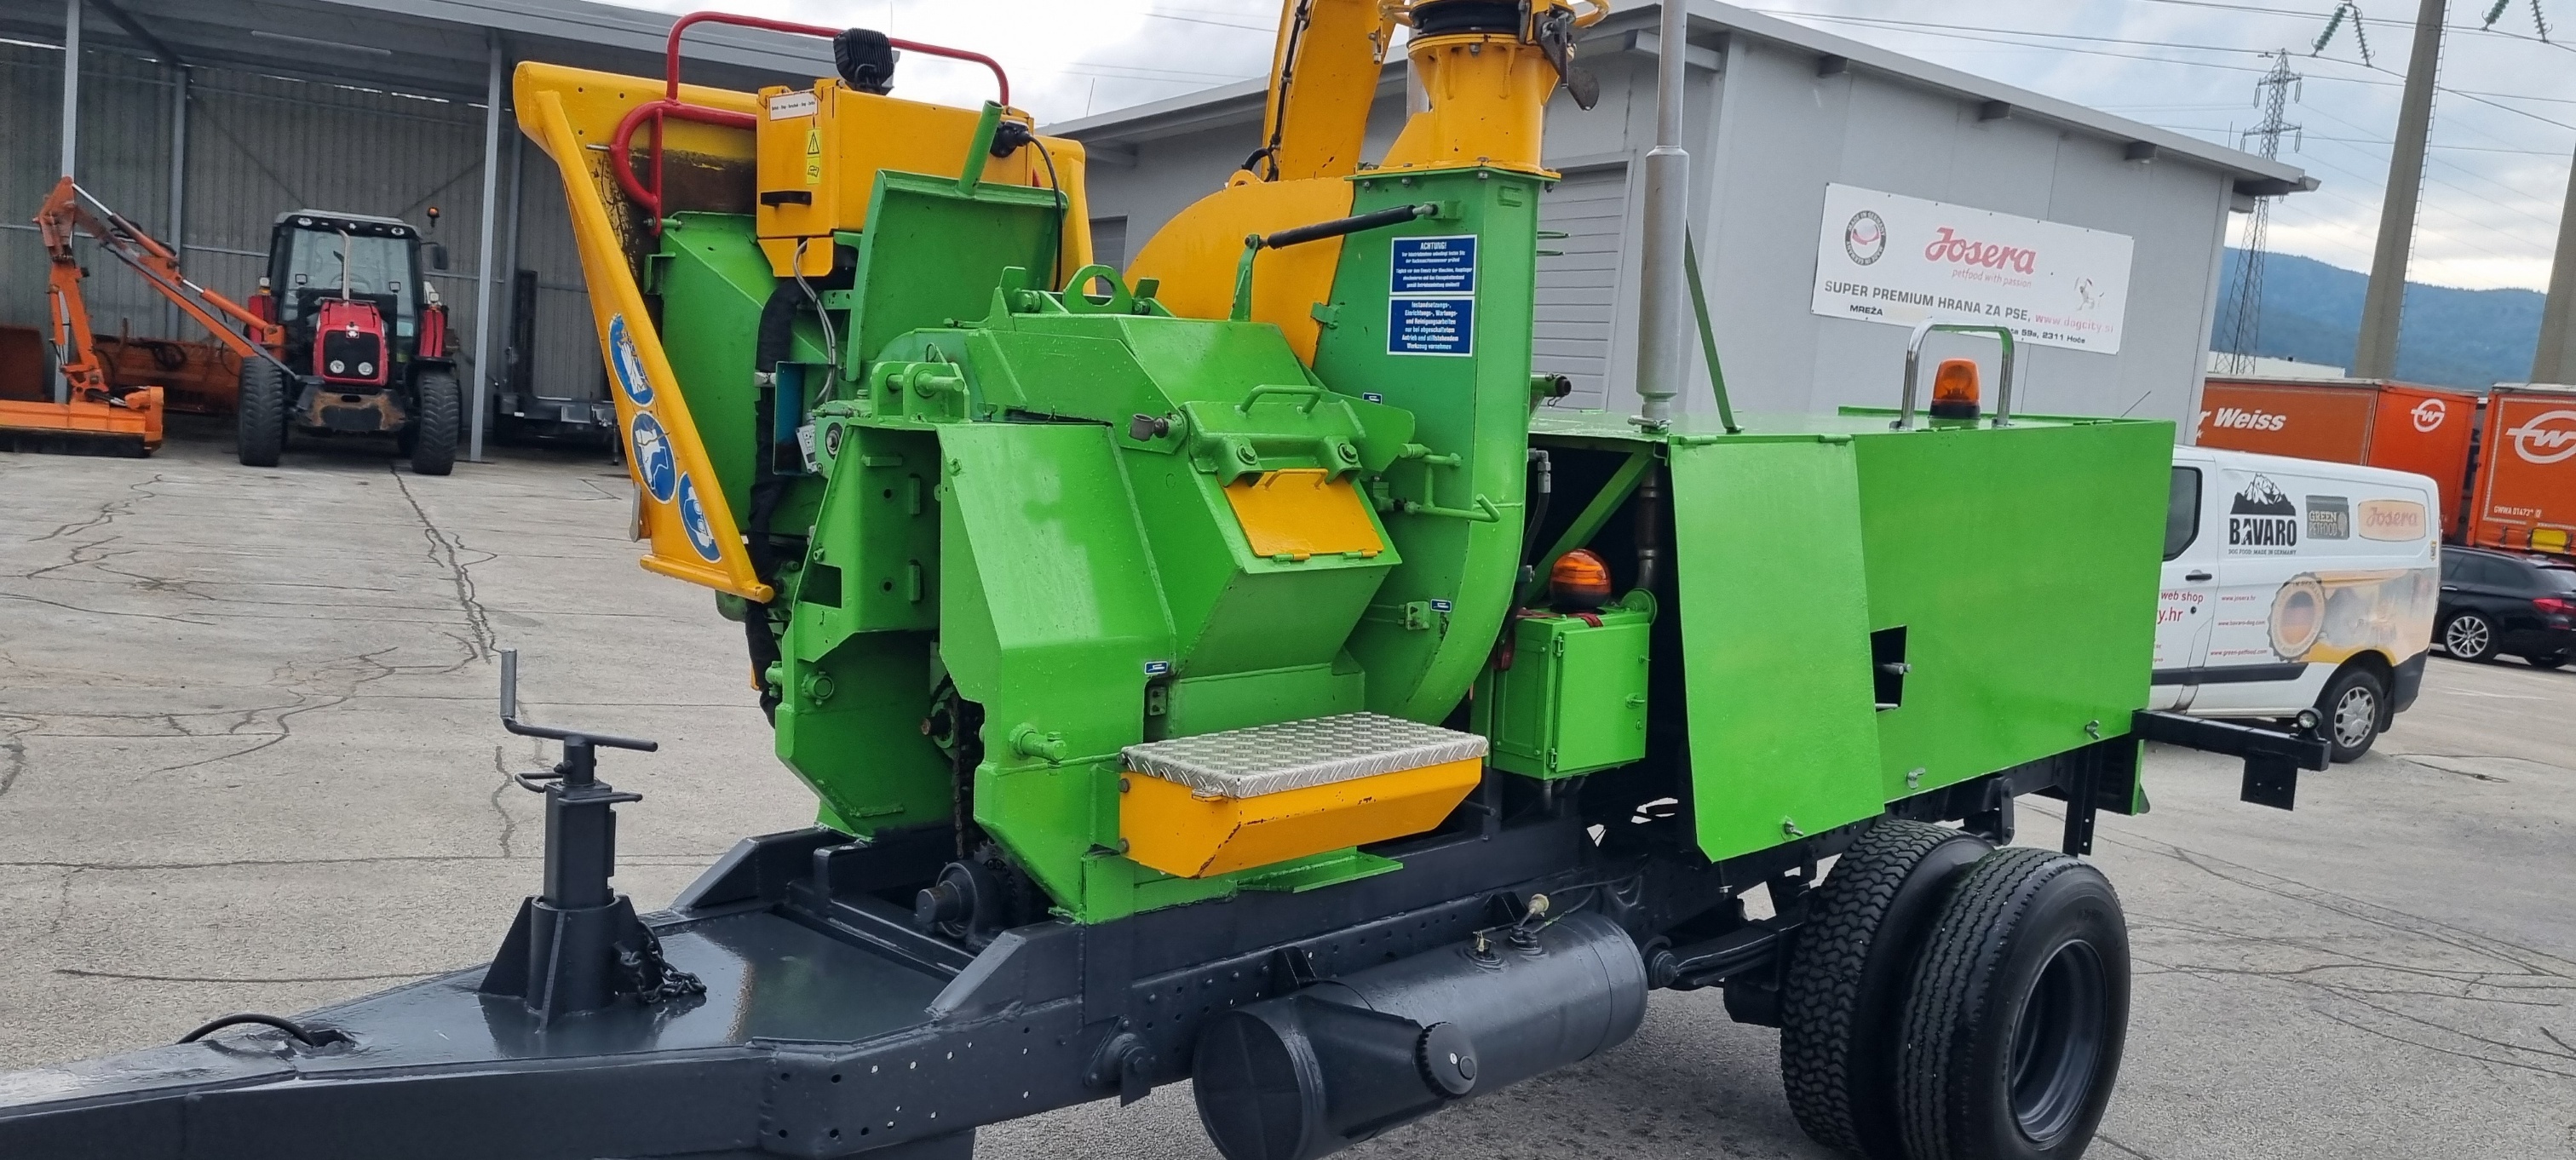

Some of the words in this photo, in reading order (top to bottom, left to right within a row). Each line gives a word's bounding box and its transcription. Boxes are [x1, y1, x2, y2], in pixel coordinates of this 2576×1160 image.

[1420, 242, 1446, 250] ACHTUNG!
[1924, 227, 2037, 275] Josera
[1952, 268, 1983, 281] petfood
[1985, 273, 2003, 284] with
[2003, 277, 2032, 289] passion
[1825, 280, 1868, 298] SUPER
[1872, 287, 1934, 307] PREMIUM
[1938, 296, 1981, 314] HRANA
[1985, 304, 2001, 317] ZA
[2005, 307, 2031, 323] PSE,
[1849, 304, 1883, 316] MREŽA
[2042, 330, 2064, 341] 2311
[2213, 407, 2286, 432] Weiss
[2309, 510, 2337, 523] GREEN
[2366, 507, 2418, 527] Josera
[2229, 518, 2297, 547] BAVARO
[2309, 522, 2337, 537] PETFOOD
[2160, 591, 2179, 600] web
[2181, 591, 2204, 605] shop
[2157, 606, 2183, 624] y.hr
